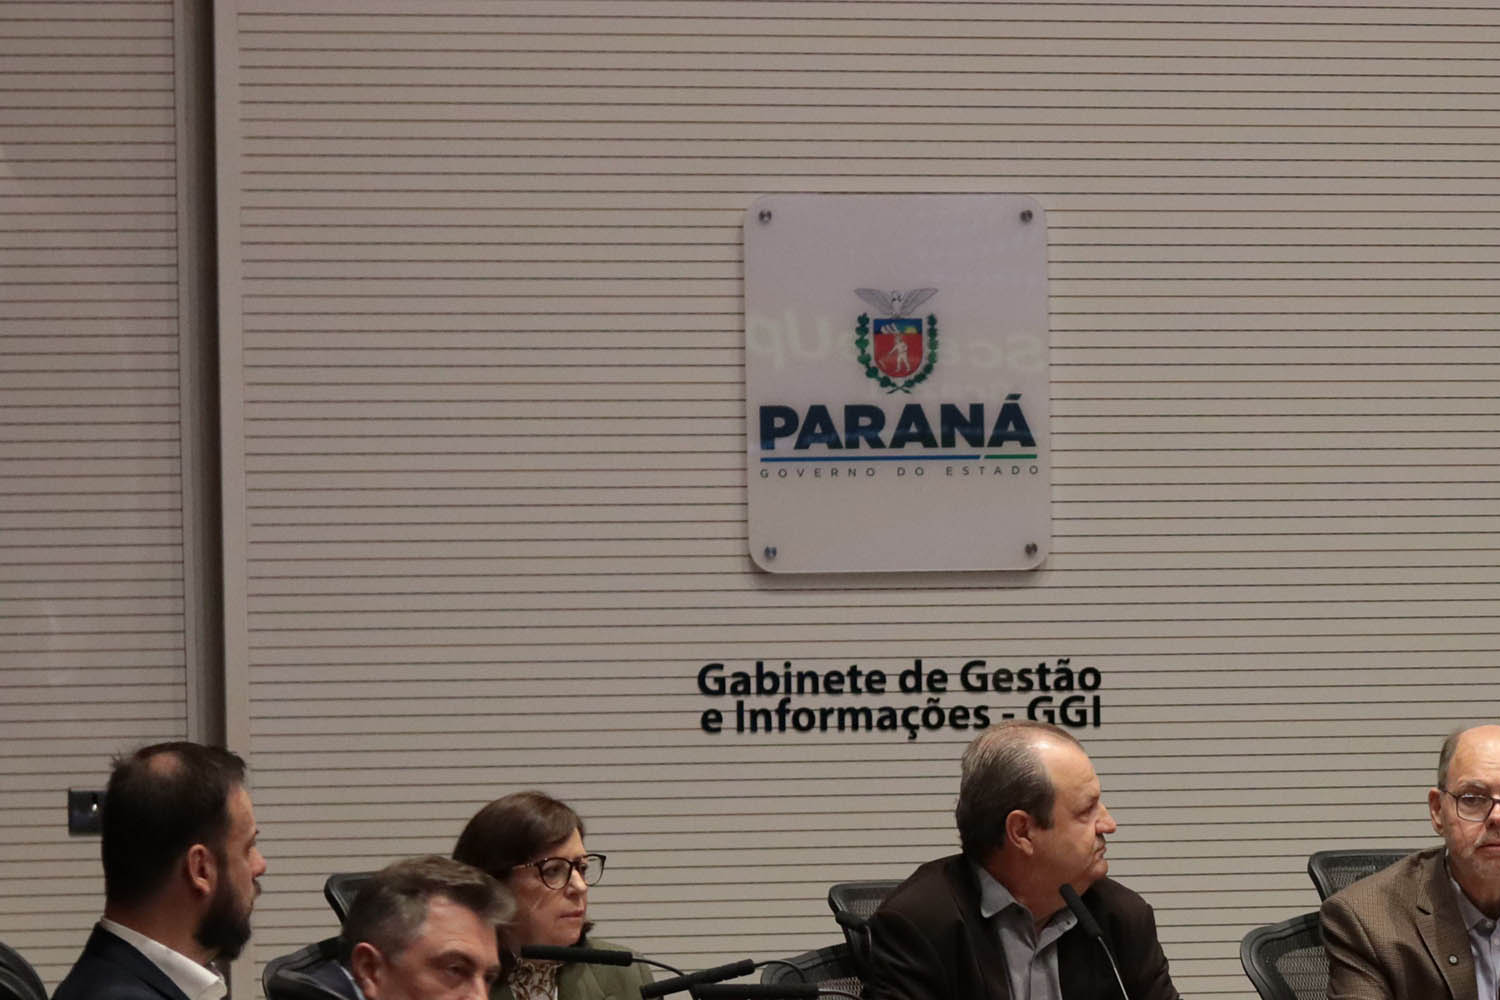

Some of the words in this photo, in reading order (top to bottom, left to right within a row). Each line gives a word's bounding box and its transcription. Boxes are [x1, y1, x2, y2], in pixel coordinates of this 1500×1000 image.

[759, 393, 1037, 450] PARANÁ
[759, 467, 875, 479] GOVERNO
[897, 465, 925, 477] DO
[946, 464, 1038, 476] ESTADO
[697, 661, 887, 697] Gabinete
[898, 659, 948, 694] de
[960, 658, 1102, 694] Gestão
[700, 707, 723, 734] e
[736, 697, 991, 740] Informações
[1027, 695, 1102, 728] GGI
